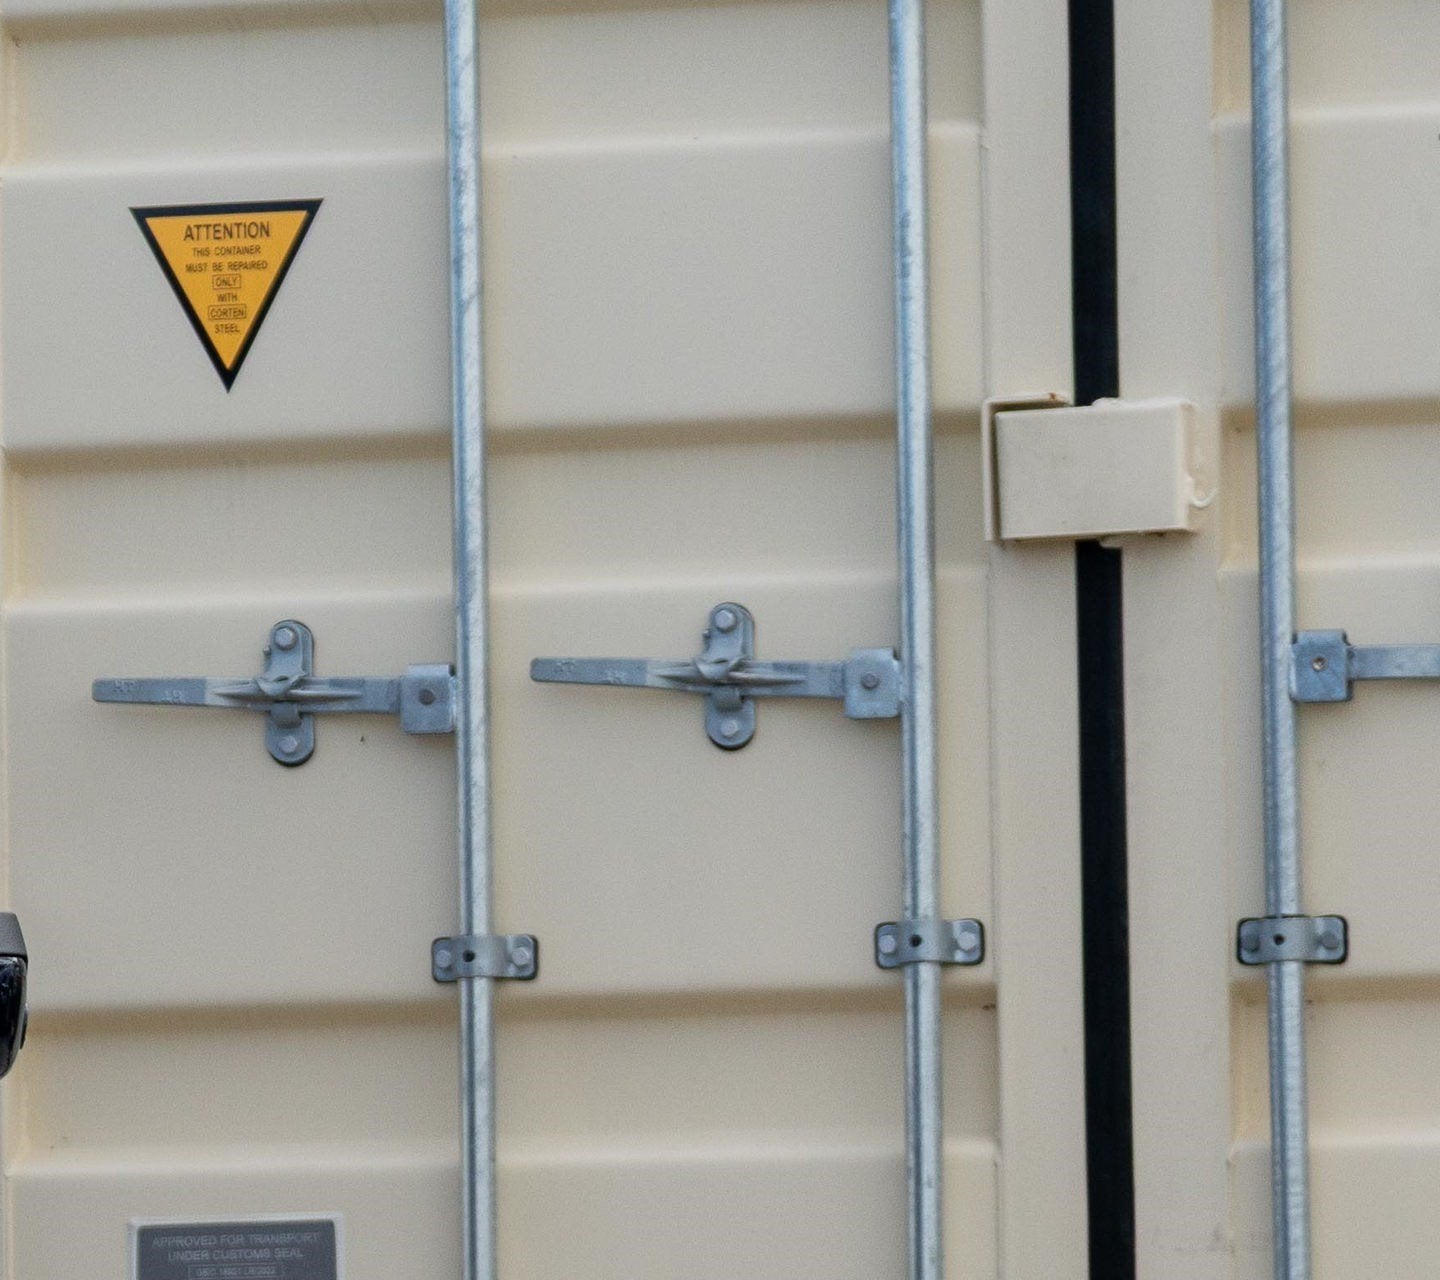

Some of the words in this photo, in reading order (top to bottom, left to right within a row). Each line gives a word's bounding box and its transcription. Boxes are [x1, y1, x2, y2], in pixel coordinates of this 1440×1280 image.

[183, 221, 271, 241] ATTENTION
[192, 246, 211, 257] THIS
[214, 244, 261, 256] CONTAINER
[185, 262, 209, 273] MUST
[212, 261, 225, 272] BE
[227, 260, 268, 271] REPAIRED
[216, 276, 238, 287] ONLY
[217, 292, 238, 302] WITH
[210, 307, 245, 319] CORTEN
[214, 323, 241, 334] STEEL
[152, 1234, 217, 1248] APPROVED
[220, 1233, 245, 1246] FOR
[248, 1232, 321, 1245] TRANSPORT
[168, 1250, 209, 1262] UNDER
[212, 1248, 271, 1260] CUSTOMS
[274, 1247, 304, 1258] SEAL
